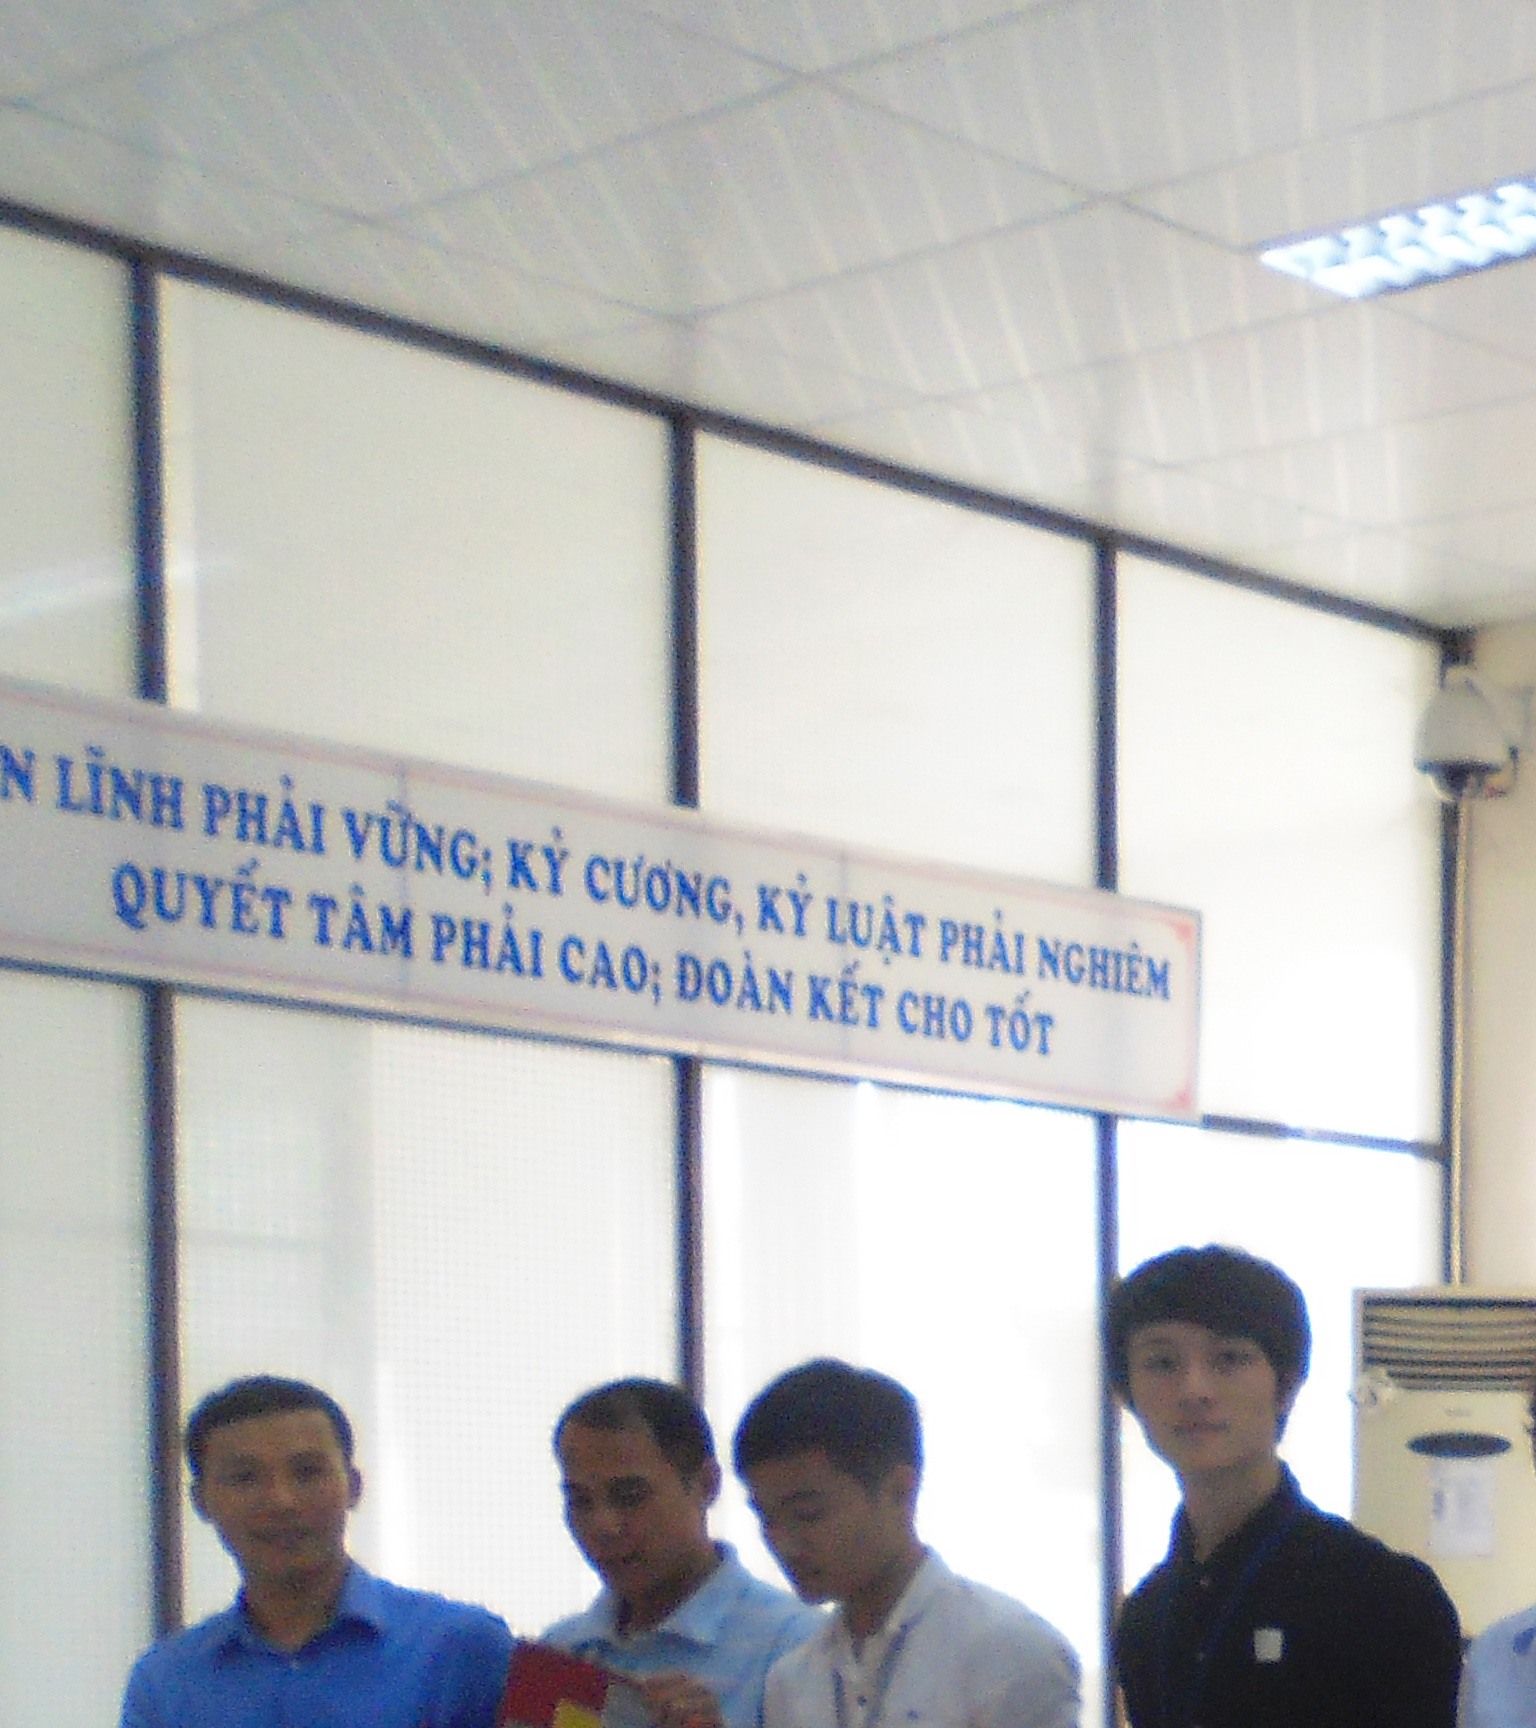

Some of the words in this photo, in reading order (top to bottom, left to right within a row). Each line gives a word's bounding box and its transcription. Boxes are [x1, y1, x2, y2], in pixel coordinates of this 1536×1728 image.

[55, 745, 185, 831] LĨNH
[202, 773, 326, 855] PHẢI
[342, 799, 493, 895] VỮNG;
[506, 826, 570, 896] KỶ
[584, 853, 745, 935] CƯƠNG,
[757, 873, 813, 937] KỶ
[827, 894, 927, 964] LUẬT
[939, 909, 1024, 975] PHẢI
[1038, 937, 1171, 1000] NGHIÊM
[112, 858, 292, 938] QUYẾT
[310, 883, 414, 959] TÂM
[431, 902, 544, 978] PHẢI
[559, 934, 663, 1005] CAO;
[676, 949, 794, 1014] ĐOÀN
[808, 959, 886, 1027] KẾT
[897, 989, 973, 1041] CHO
[985, 989, 1055, 1055] TỐT
